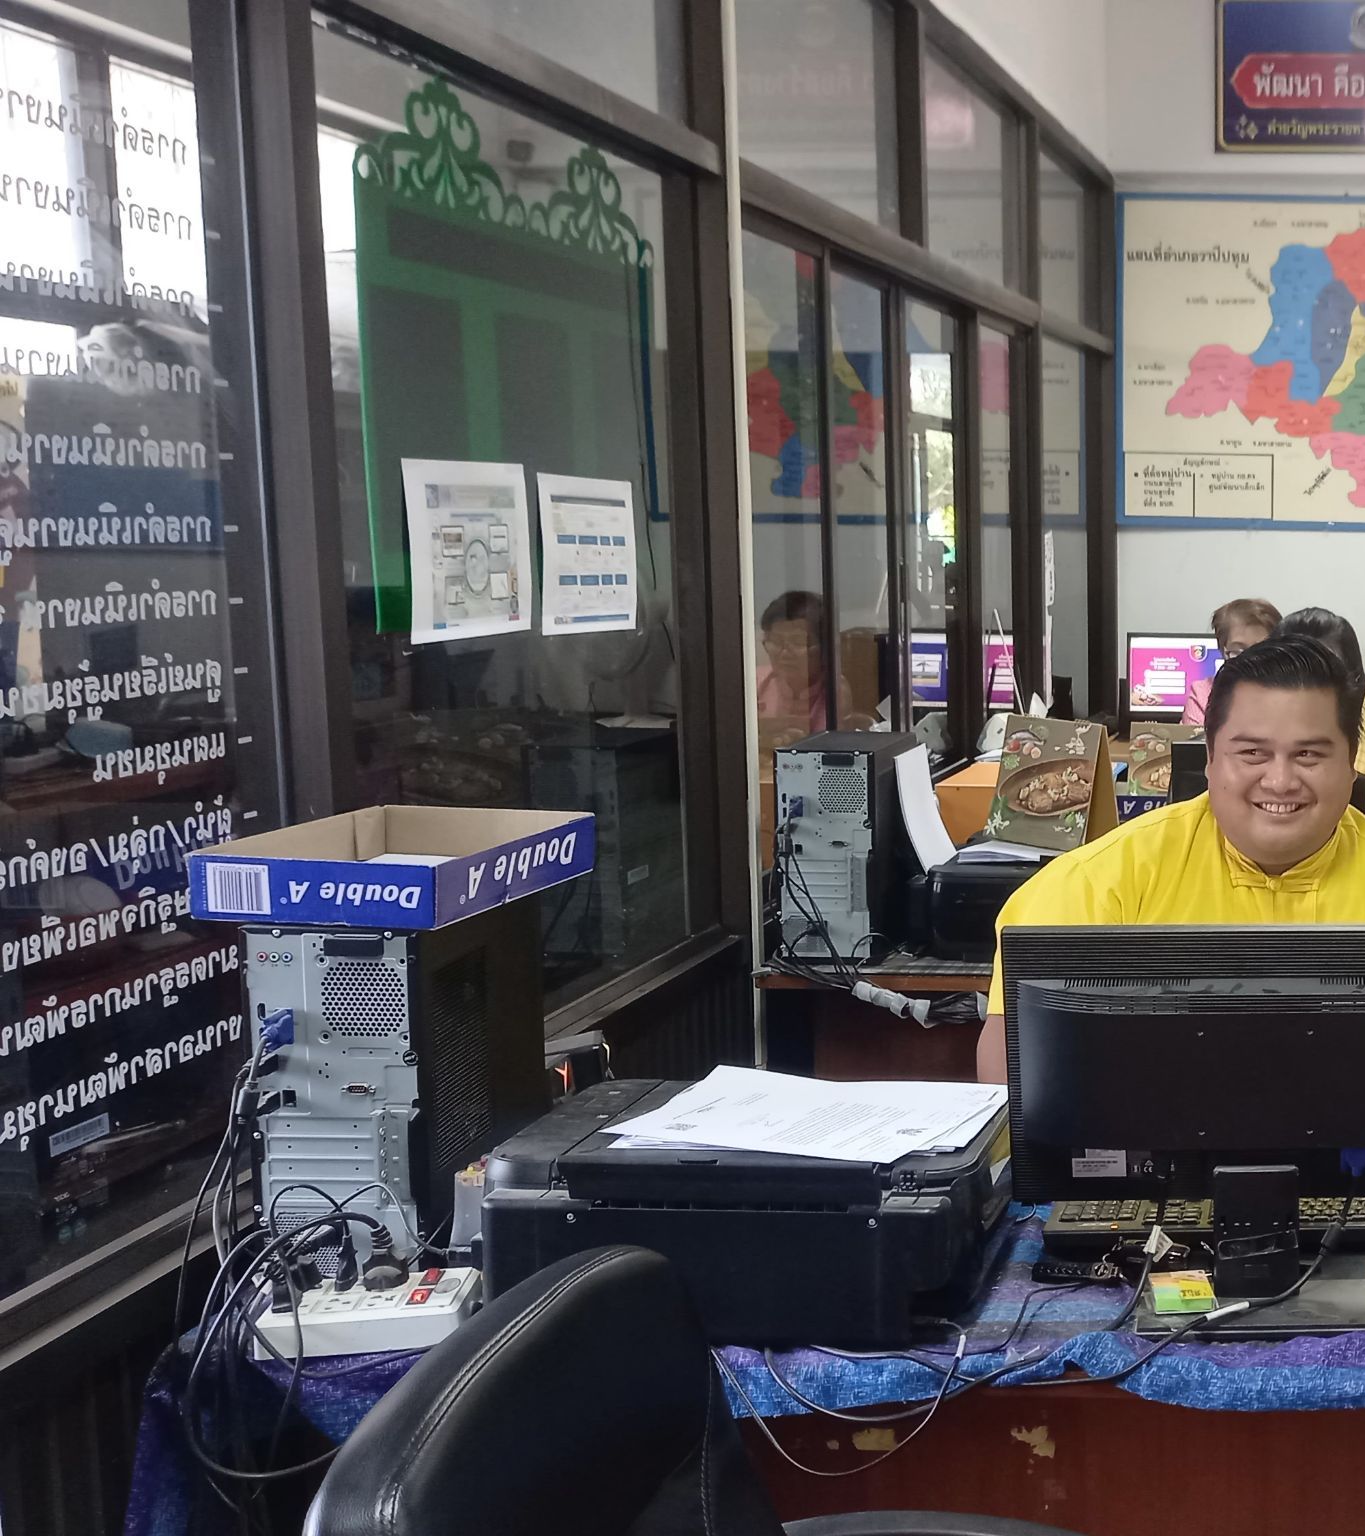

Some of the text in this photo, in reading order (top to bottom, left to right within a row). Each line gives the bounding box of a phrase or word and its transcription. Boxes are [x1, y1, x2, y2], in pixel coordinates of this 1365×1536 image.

[1253, 62, 1323, 98] พัฒนา
[468, 831, 577, 900] Double A
[288, 880, 422, 909] Double A
